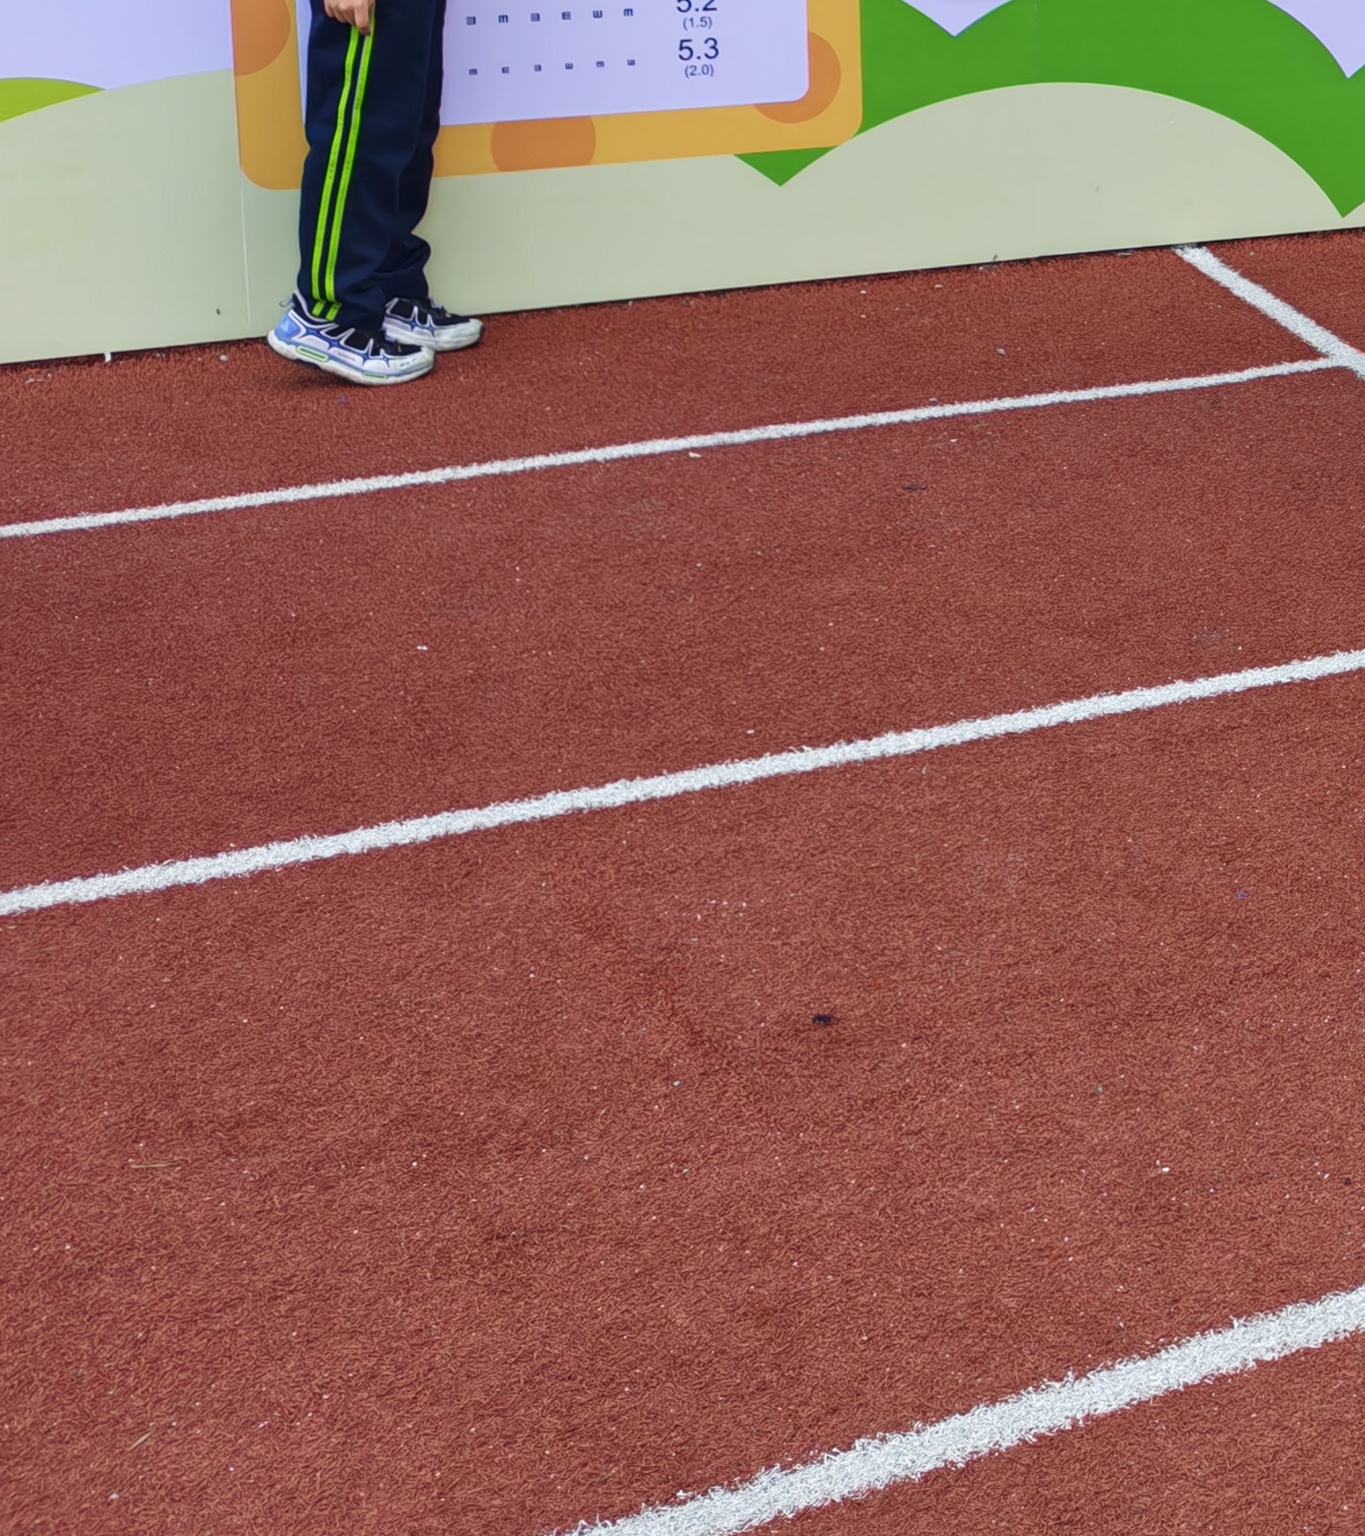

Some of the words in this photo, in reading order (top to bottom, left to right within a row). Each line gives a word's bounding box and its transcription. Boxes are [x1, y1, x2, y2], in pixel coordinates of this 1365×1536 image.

[683, 17, 712, 31] (1.5)
[678, 38, 719, 61] 5.3
[685, 64, 714, 78] (2.0)
